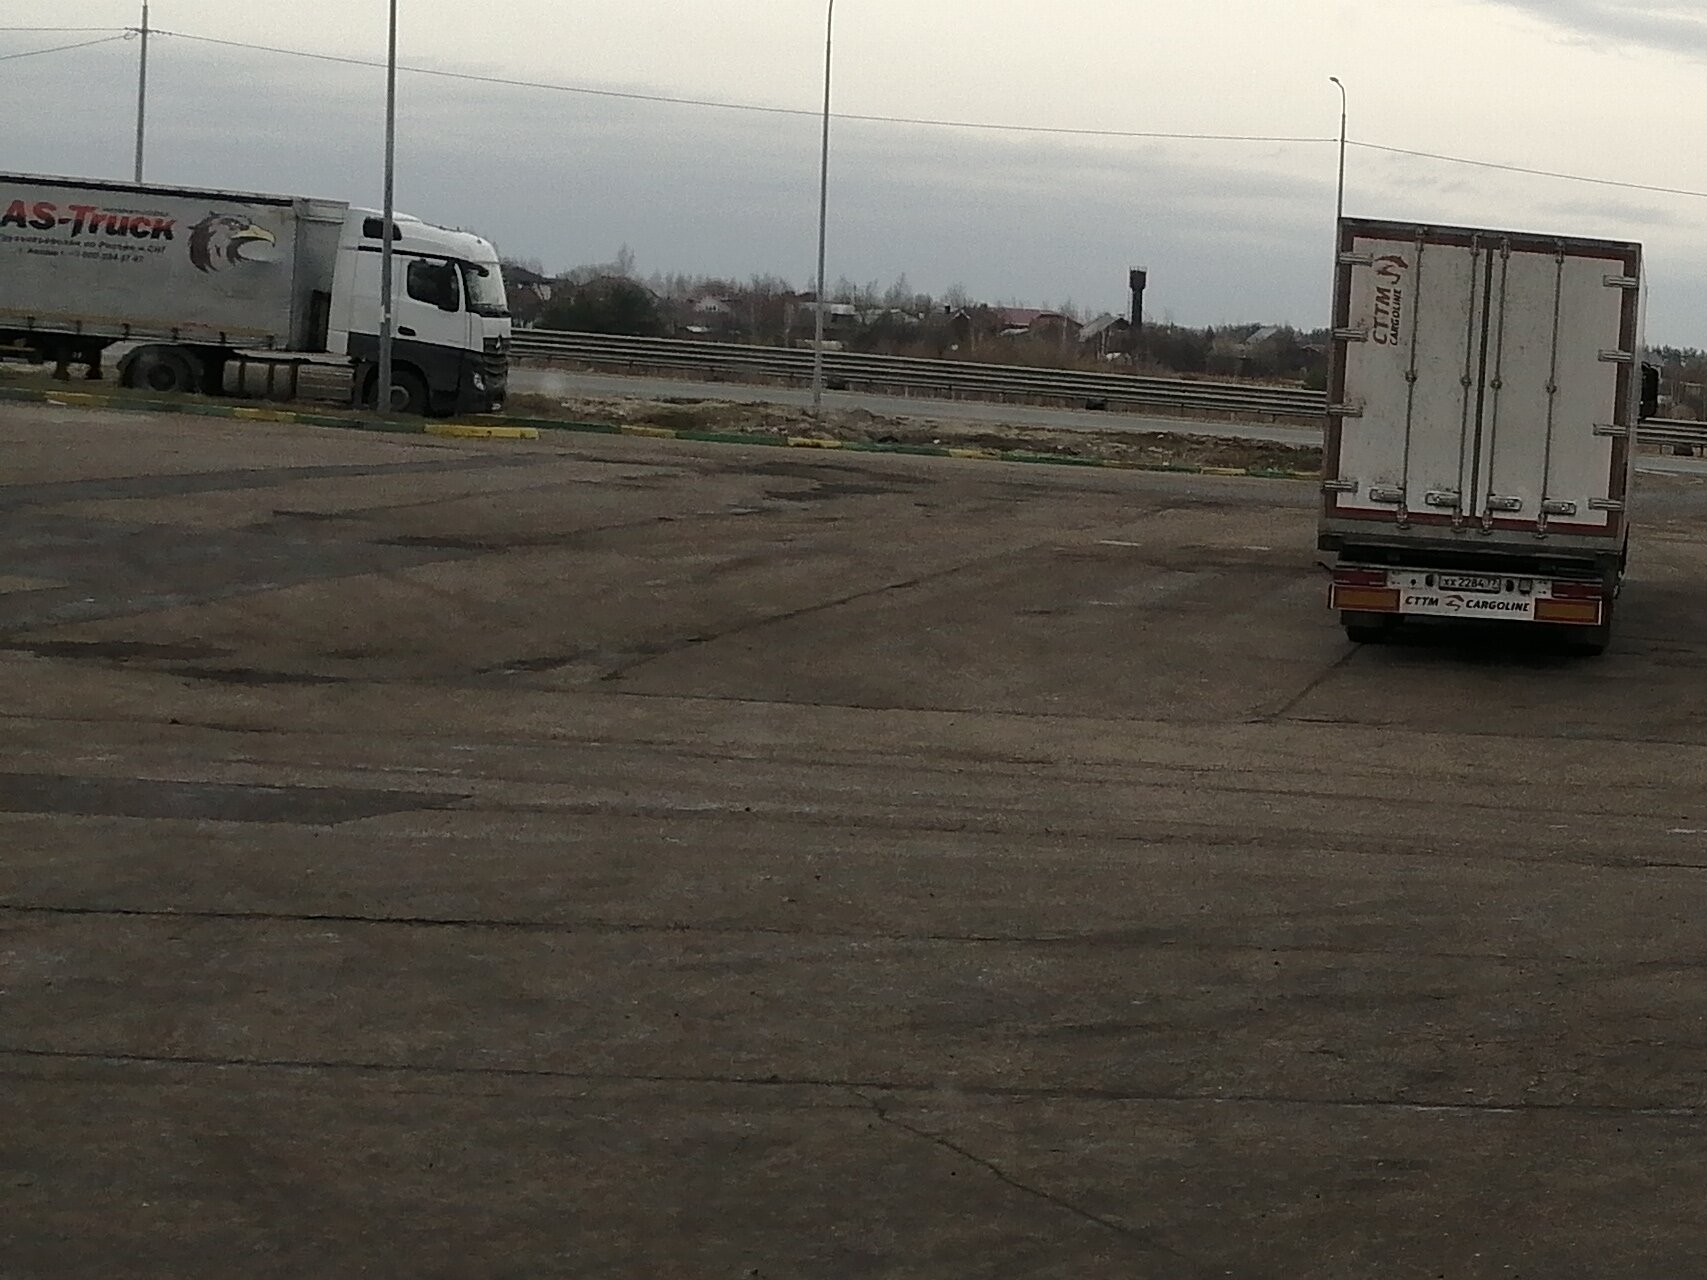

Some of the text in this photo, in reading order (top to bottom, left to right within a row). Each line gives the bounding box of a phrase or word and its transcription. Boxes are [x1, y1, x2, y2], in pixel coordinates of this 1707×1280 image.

[0, 199, 177, 241] AS-Truck
[1390, 288, 1402, 346] CARGOLINE
[1465, 599, 1530, 613] CARGOLINE
